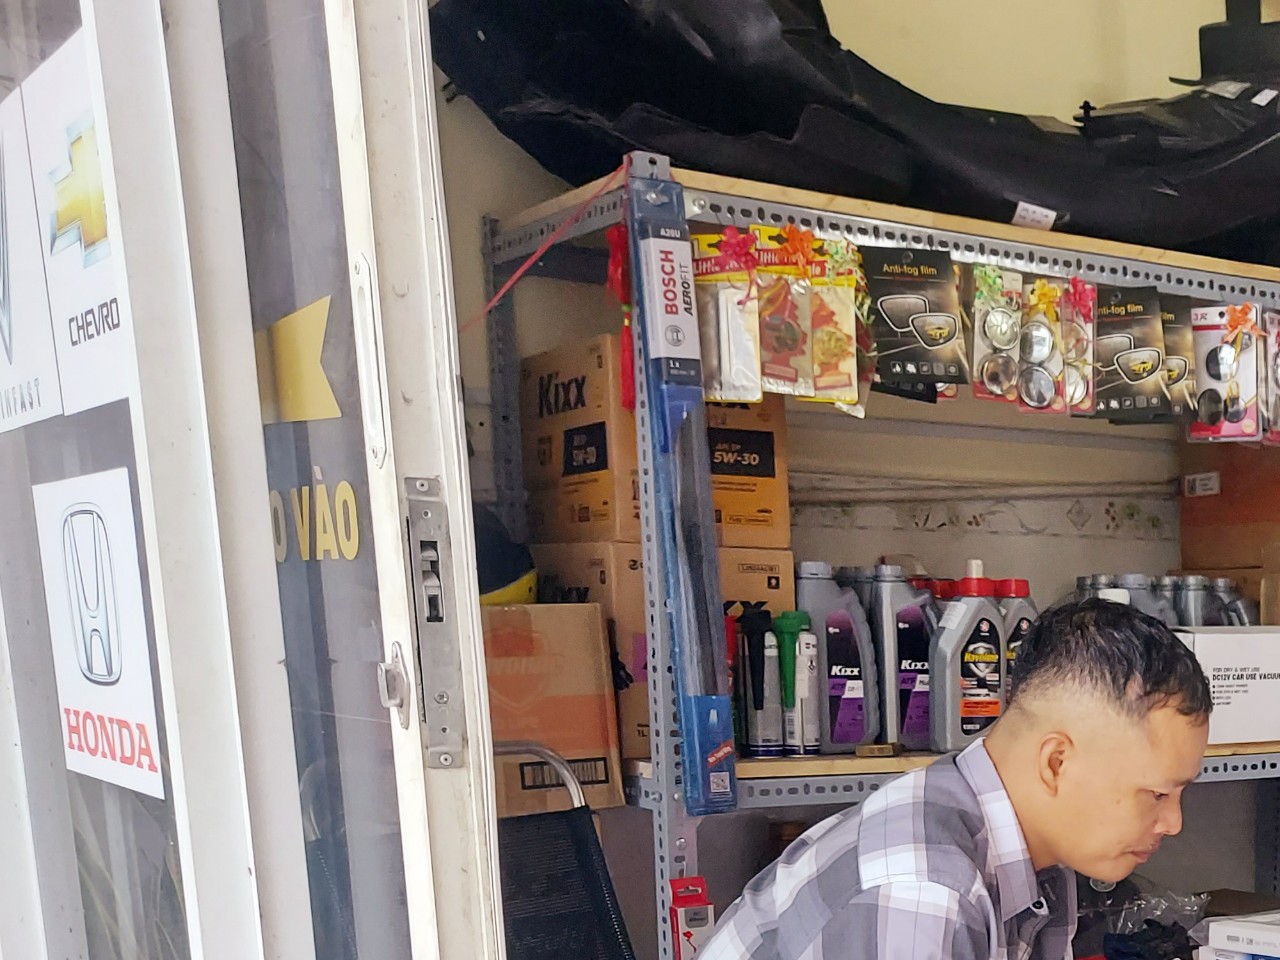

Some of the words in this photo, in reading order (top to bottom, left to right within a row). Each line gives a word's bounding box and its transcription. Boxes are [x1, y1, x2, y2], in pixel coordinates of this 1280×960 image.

[659, 249, 679, 316] BOSCH
[883, 263, 919, 276] Anti-fog
[679, 263, 694, 317] AEROFIT
[1097, 304, 1126, 315] nti-fog
[538, 371, 587, 418] Kixx
[713, 451, 760, 465] 5W-30
[290, 465, 359, 561] VÀO
[831, 665, 860, 676] Kixx
[1232, 673, 1244, 681] CAR
[64, 707, 158, 773] HONDA
